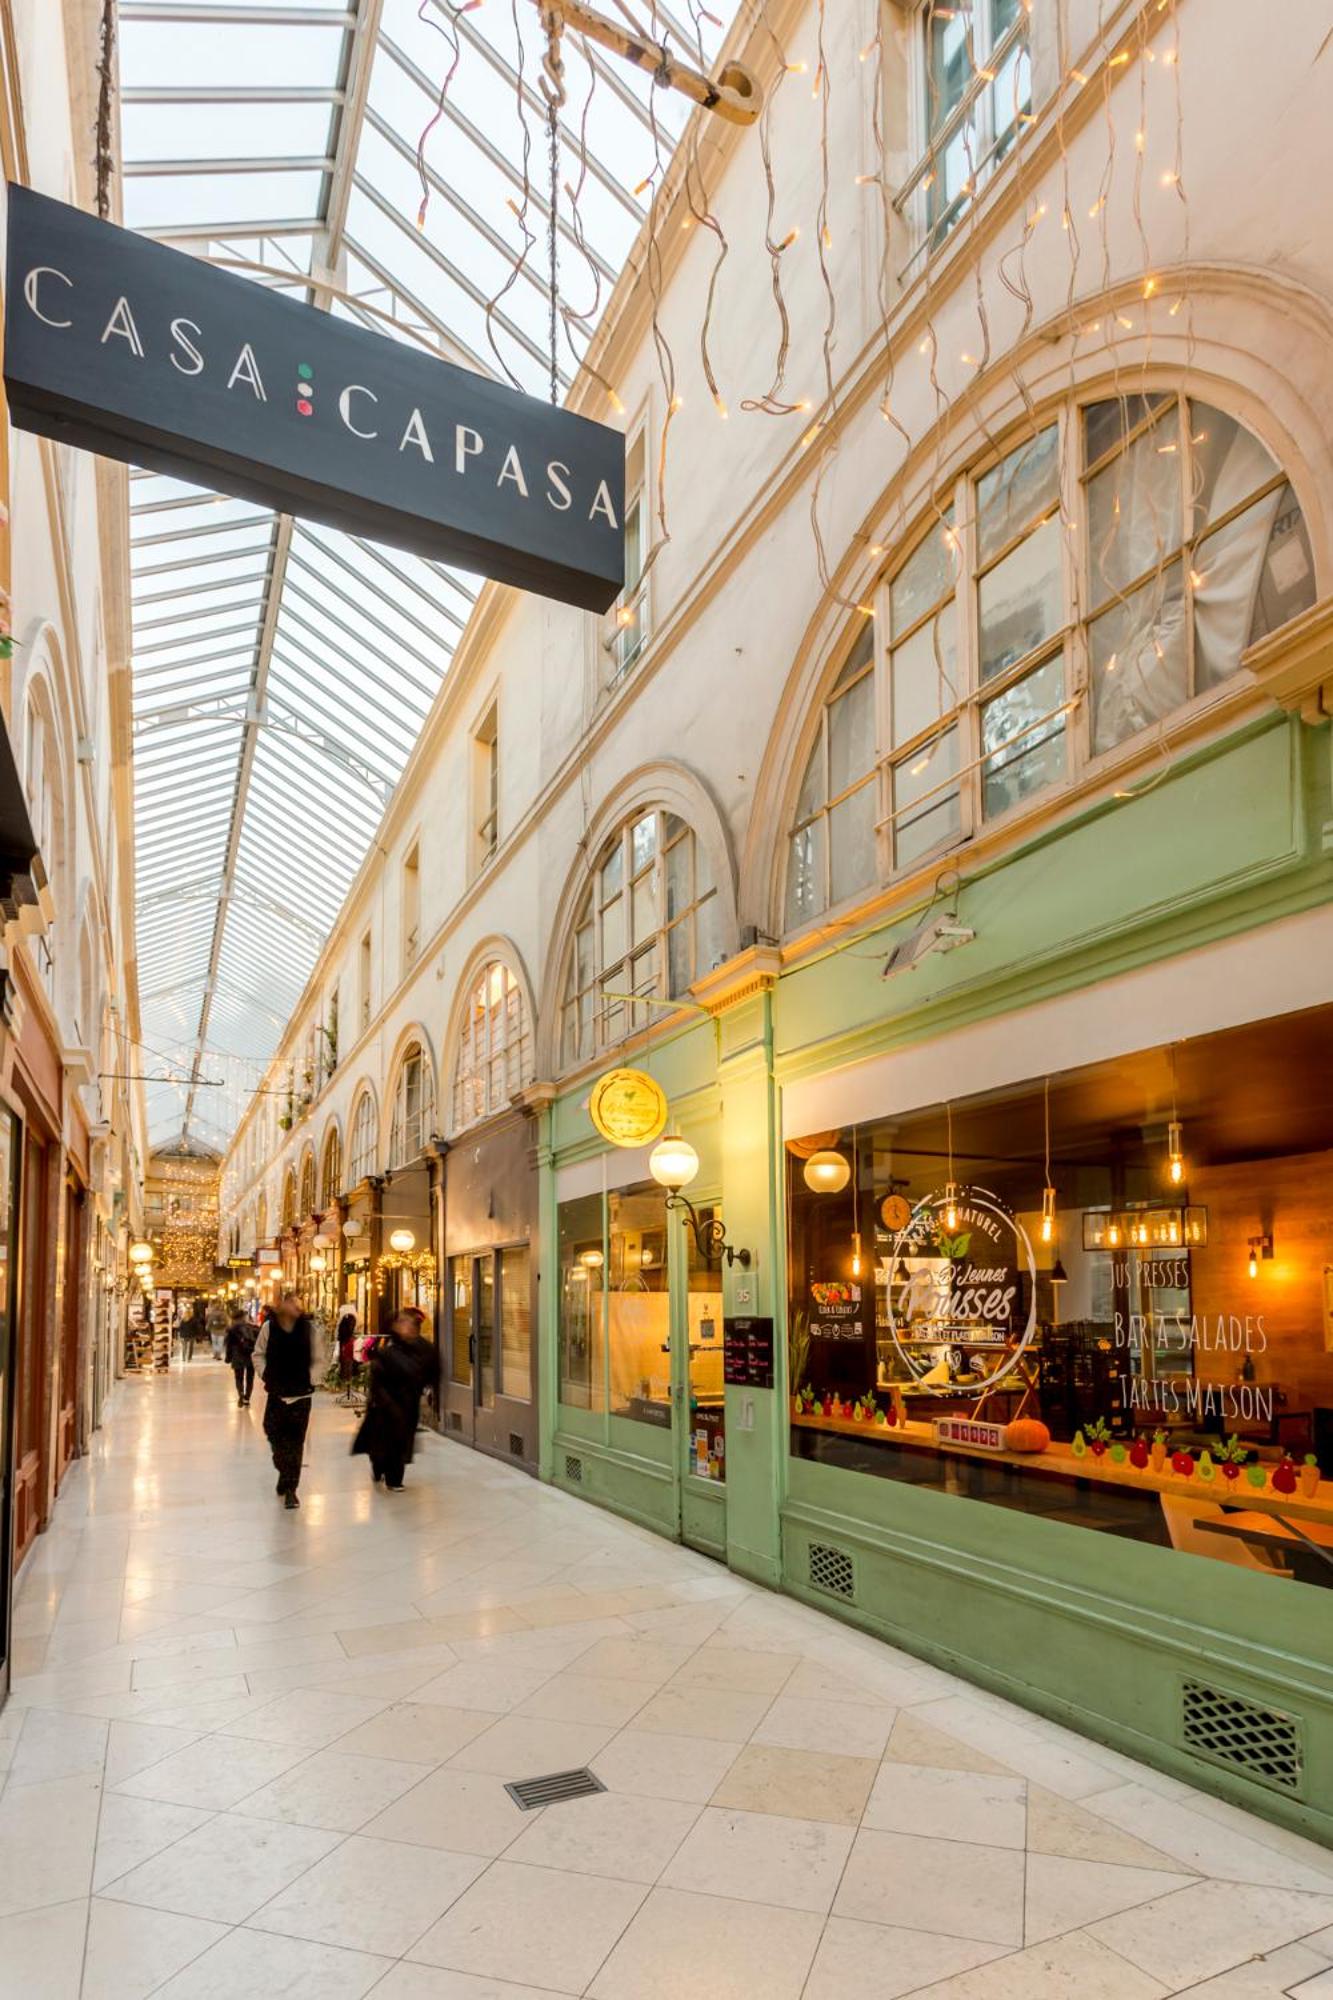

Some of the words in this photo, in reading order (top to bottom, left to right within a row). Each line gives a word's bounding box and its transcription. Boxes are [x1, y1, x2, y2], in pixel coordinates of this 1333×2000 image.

[23, 266, 268, 402] CASA
[338, 384, 620, 531] CAPASA
[959, 1207, 1002, 1243] NATUREL
[736, 1289, 751, 1304] 35
[898, 1267, 1017, 1322] Pousses
[1109, 1261, 1131, 1291] JUS
[1114, 1311, 1149, 1350] BAR
[1176, 1314, 1268, 1353] SALADES
[1119, 1373, 1179, 1413] TARTES
[1186, 1376, 1273, 1423] MAISON
